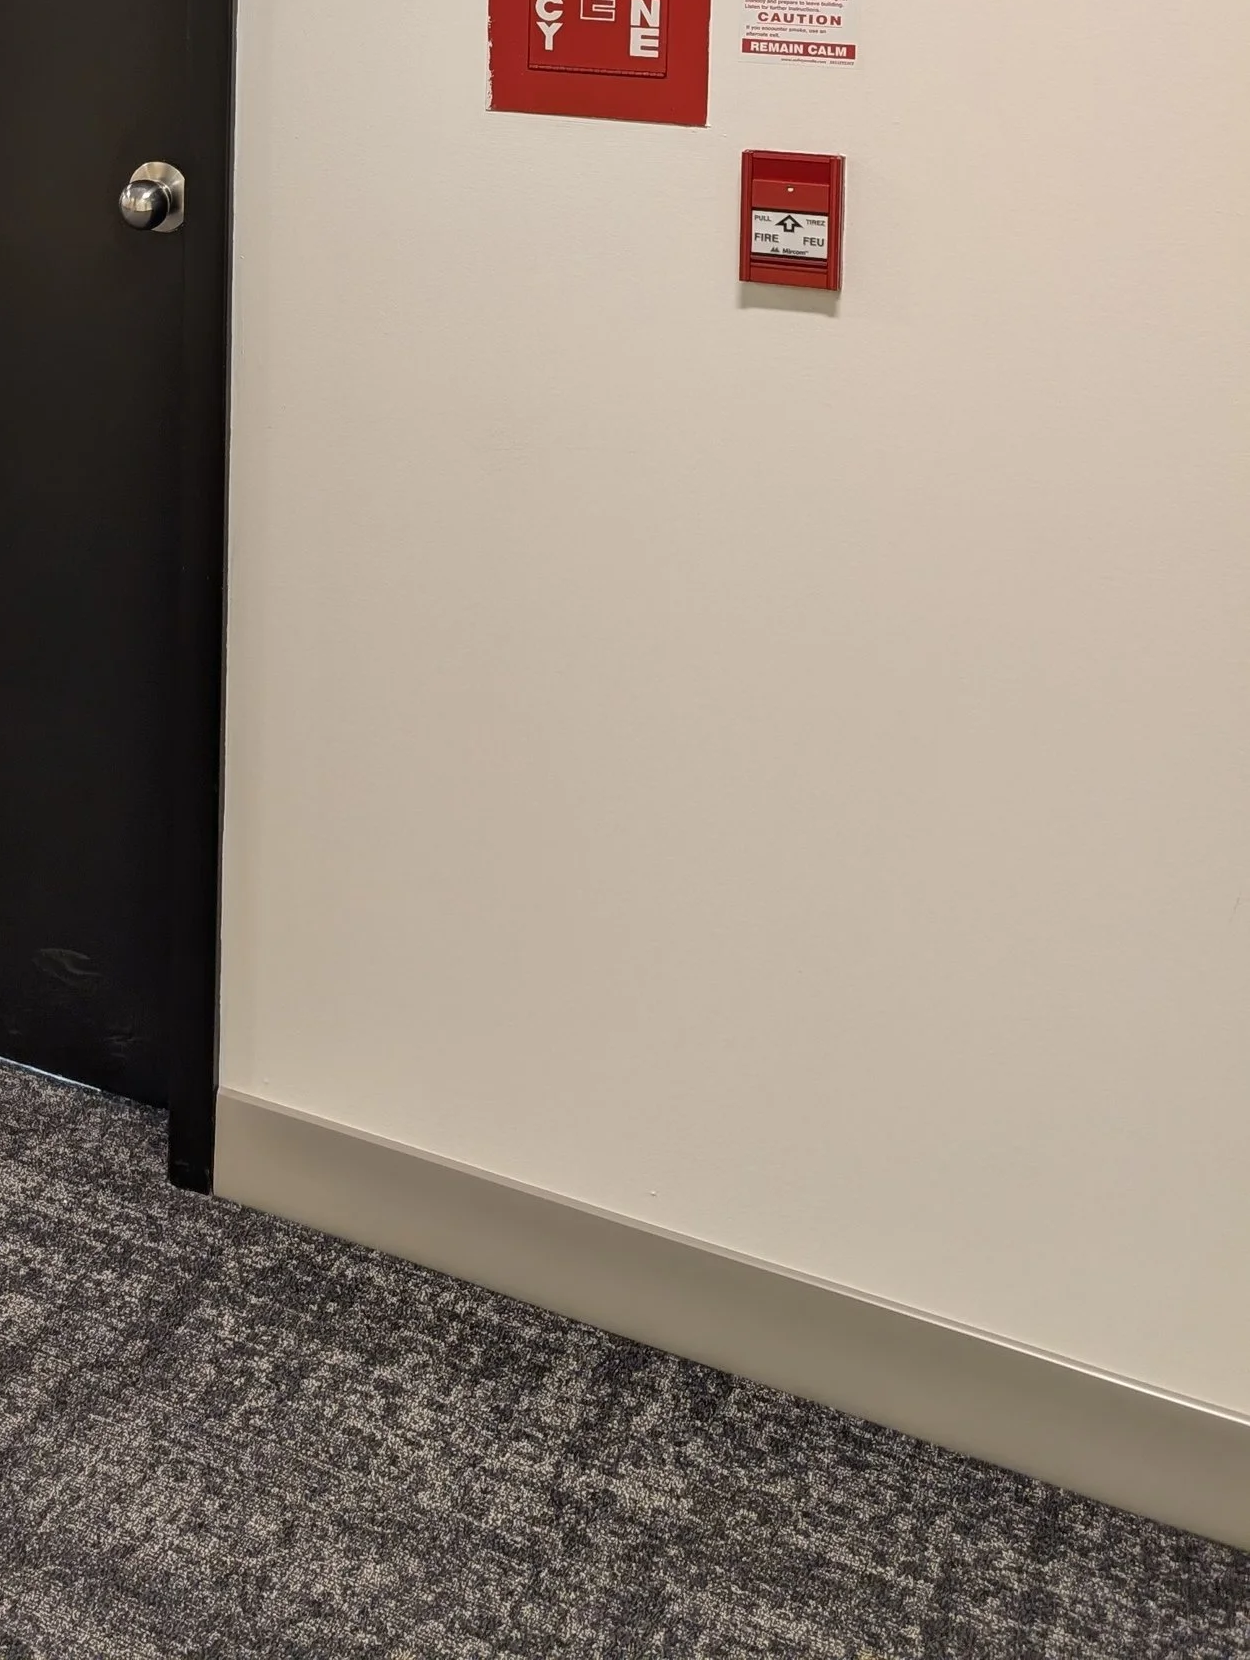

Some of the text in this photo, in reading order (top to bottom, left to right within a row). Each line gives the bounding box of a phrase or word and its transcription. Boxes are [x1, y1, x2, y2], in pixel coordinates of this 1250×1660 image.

[758, 12, 842, 26] CAUTION
[750, 42, 847, 57] REMAIN CALM
[754, 214, 771, 222] PULL
[754, 233, 779, 243] FIRE
[803, 237, 824, 247] FEU
